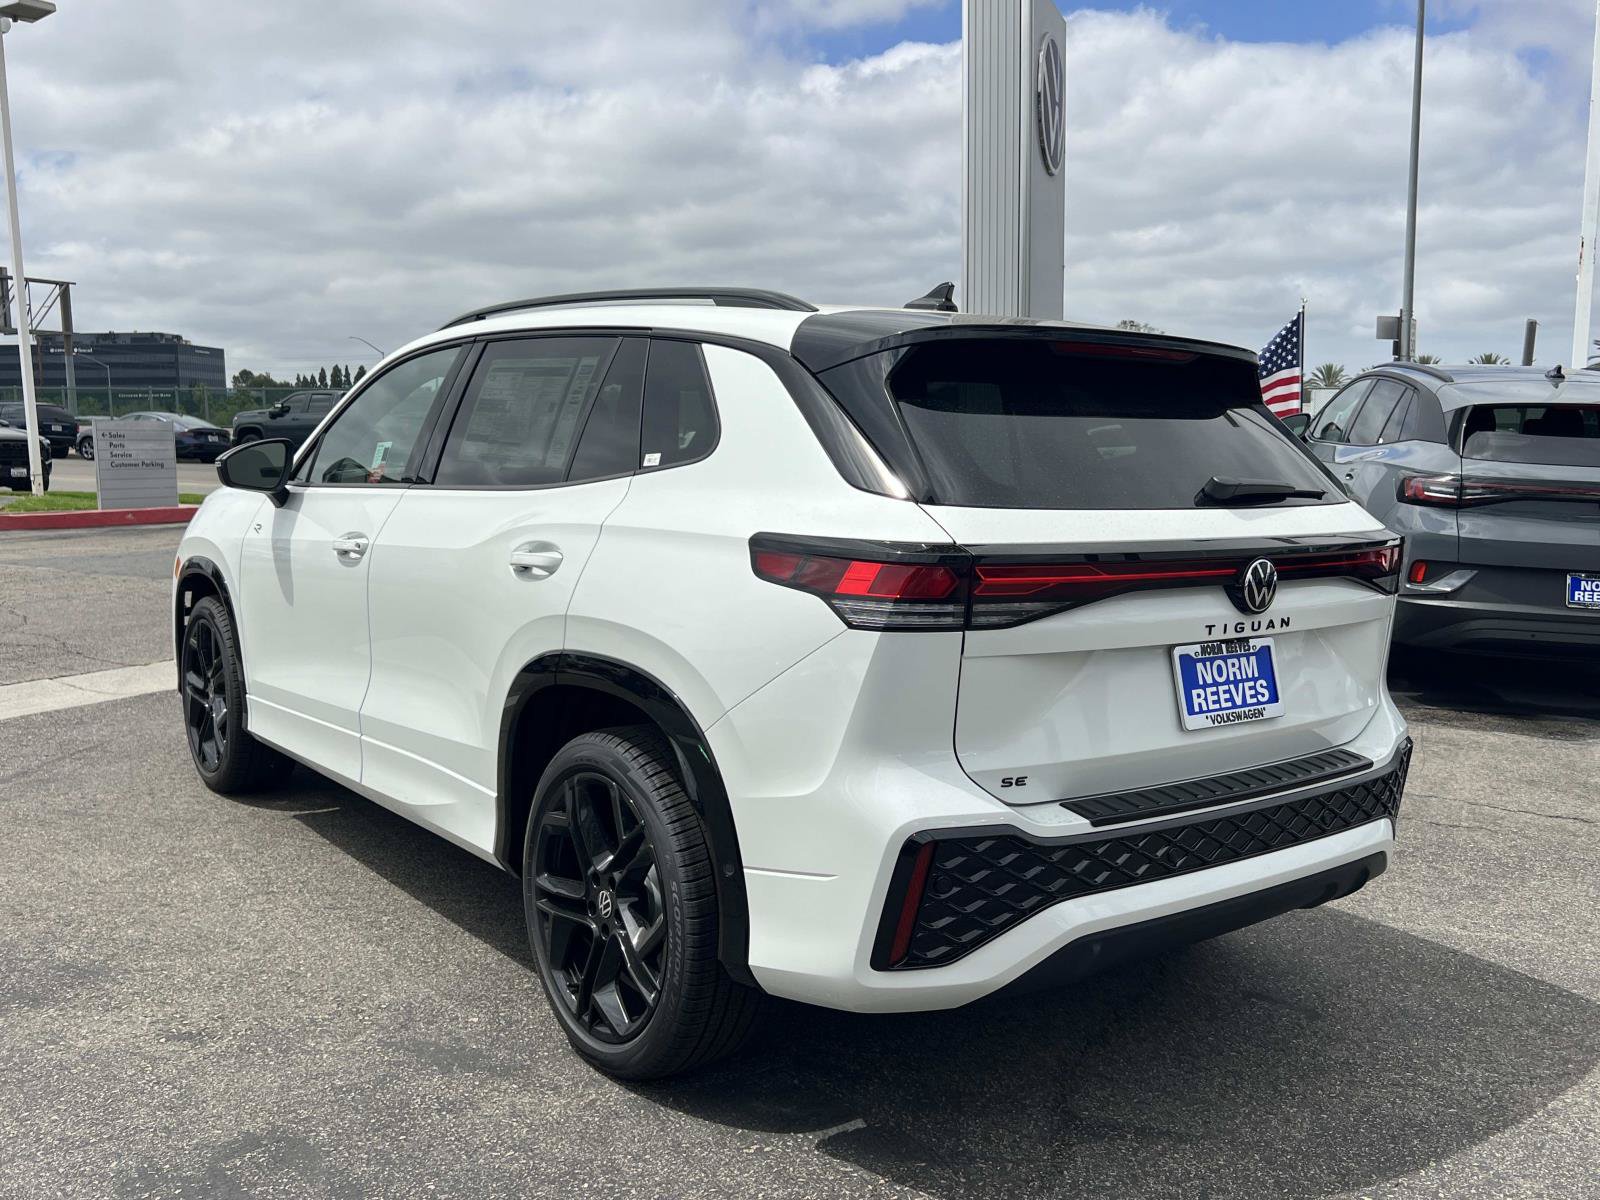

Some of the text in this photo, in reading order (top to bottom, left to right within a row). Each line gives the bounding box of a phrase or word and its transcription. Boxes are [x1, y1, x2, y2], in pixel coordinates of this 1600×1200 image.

[110, 451, 132, 459] Service
[141, 460, 164, 469] Parking
[1205, 616, 1290, 636] TIGUAN
[1200, 642, 1224, 657] NORM
[1196, 656, 1259, 685] NORM
[1191, 679, 1269, 713] REEVES
[1000, 776, 1028, 788] SE
